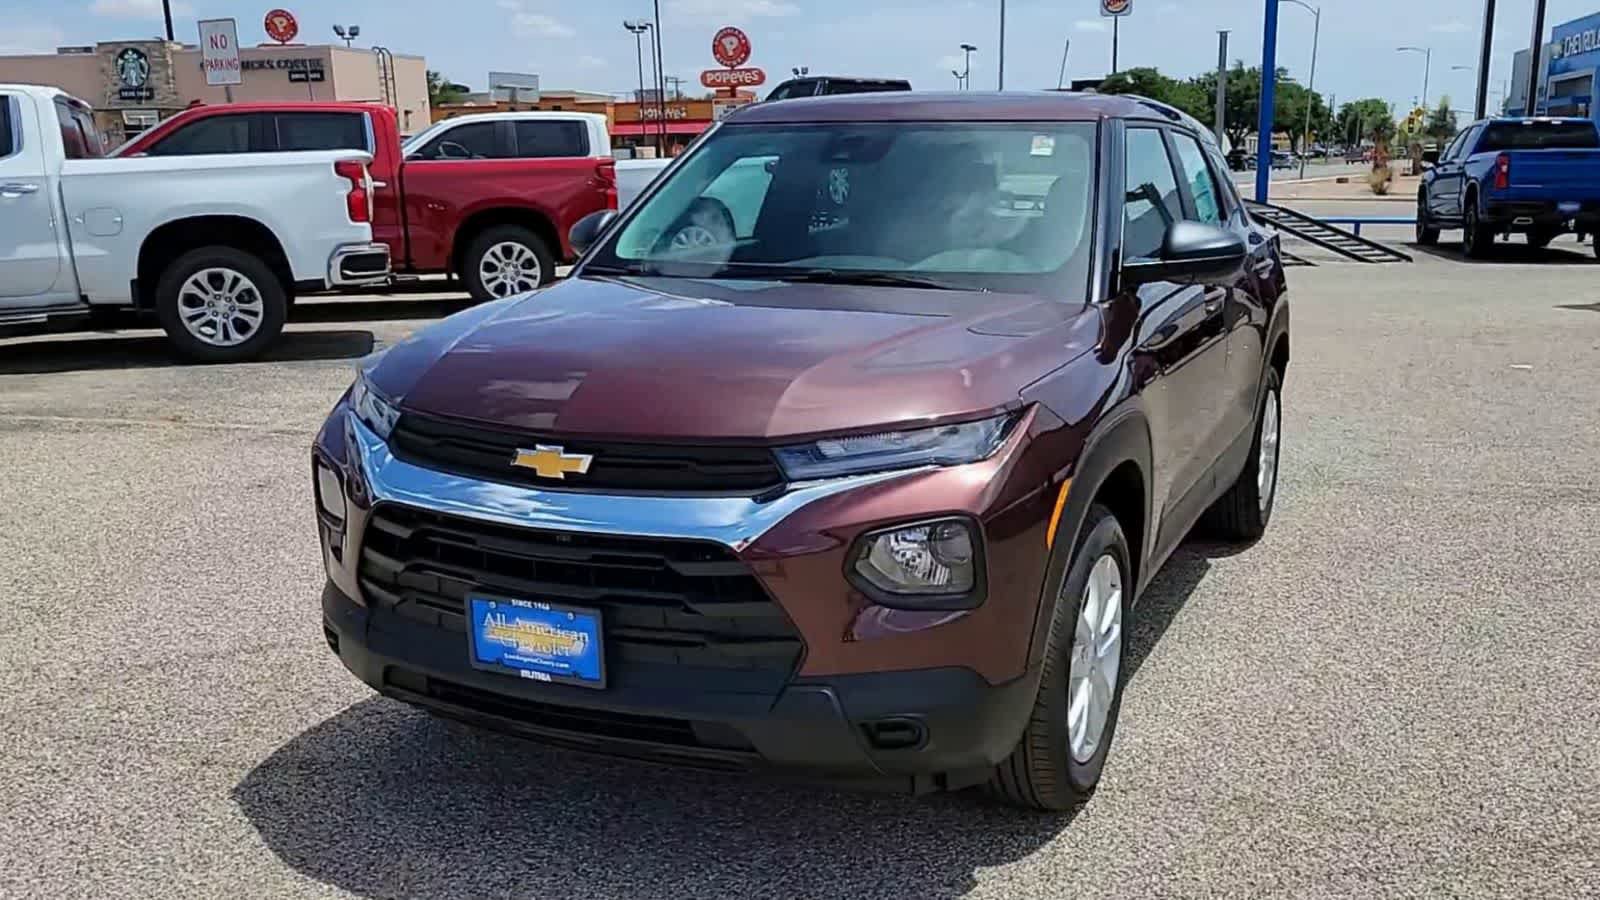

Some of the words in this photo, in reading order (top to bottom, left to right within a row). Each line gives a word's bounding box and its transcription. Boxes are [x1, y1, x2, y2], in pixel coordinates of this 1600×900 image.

[210, 34, 228, 49] NO
[205, 58, 239, 72] PARKING
[484, 612, 506, 629] All
[513, 617, 589, 642] American
